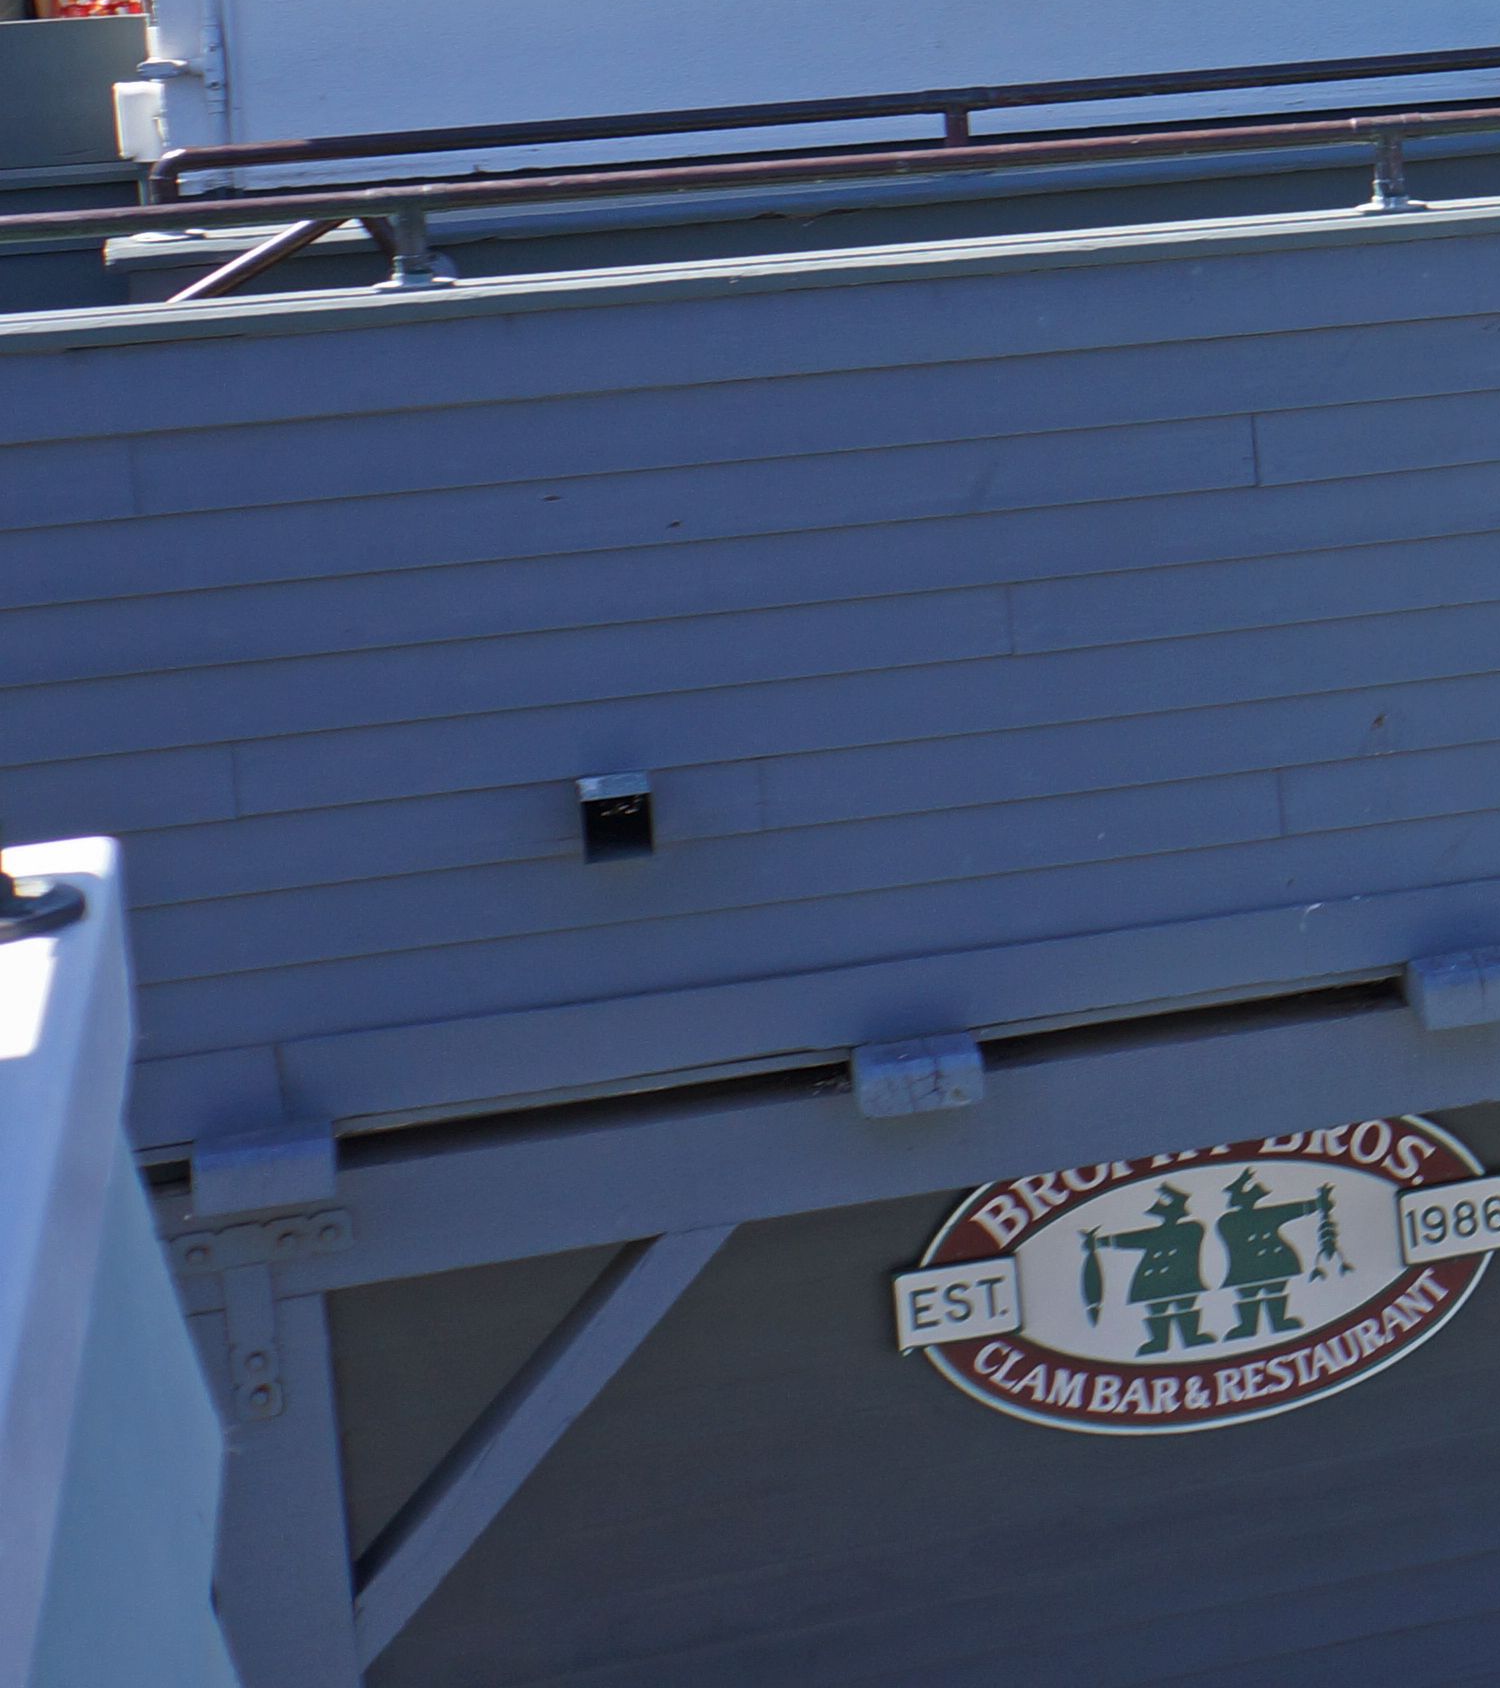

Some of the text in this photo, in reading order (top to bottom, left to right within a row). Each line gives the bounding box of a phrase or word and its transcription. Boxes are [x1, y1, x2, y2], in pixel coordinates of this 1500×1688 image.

[968, 1144, 1231, 1250] BRO
[907, 1276, 1008, 1331] EST.
[974, 1267, 1449, 1414] CLAM BAR & RESTAURANT
